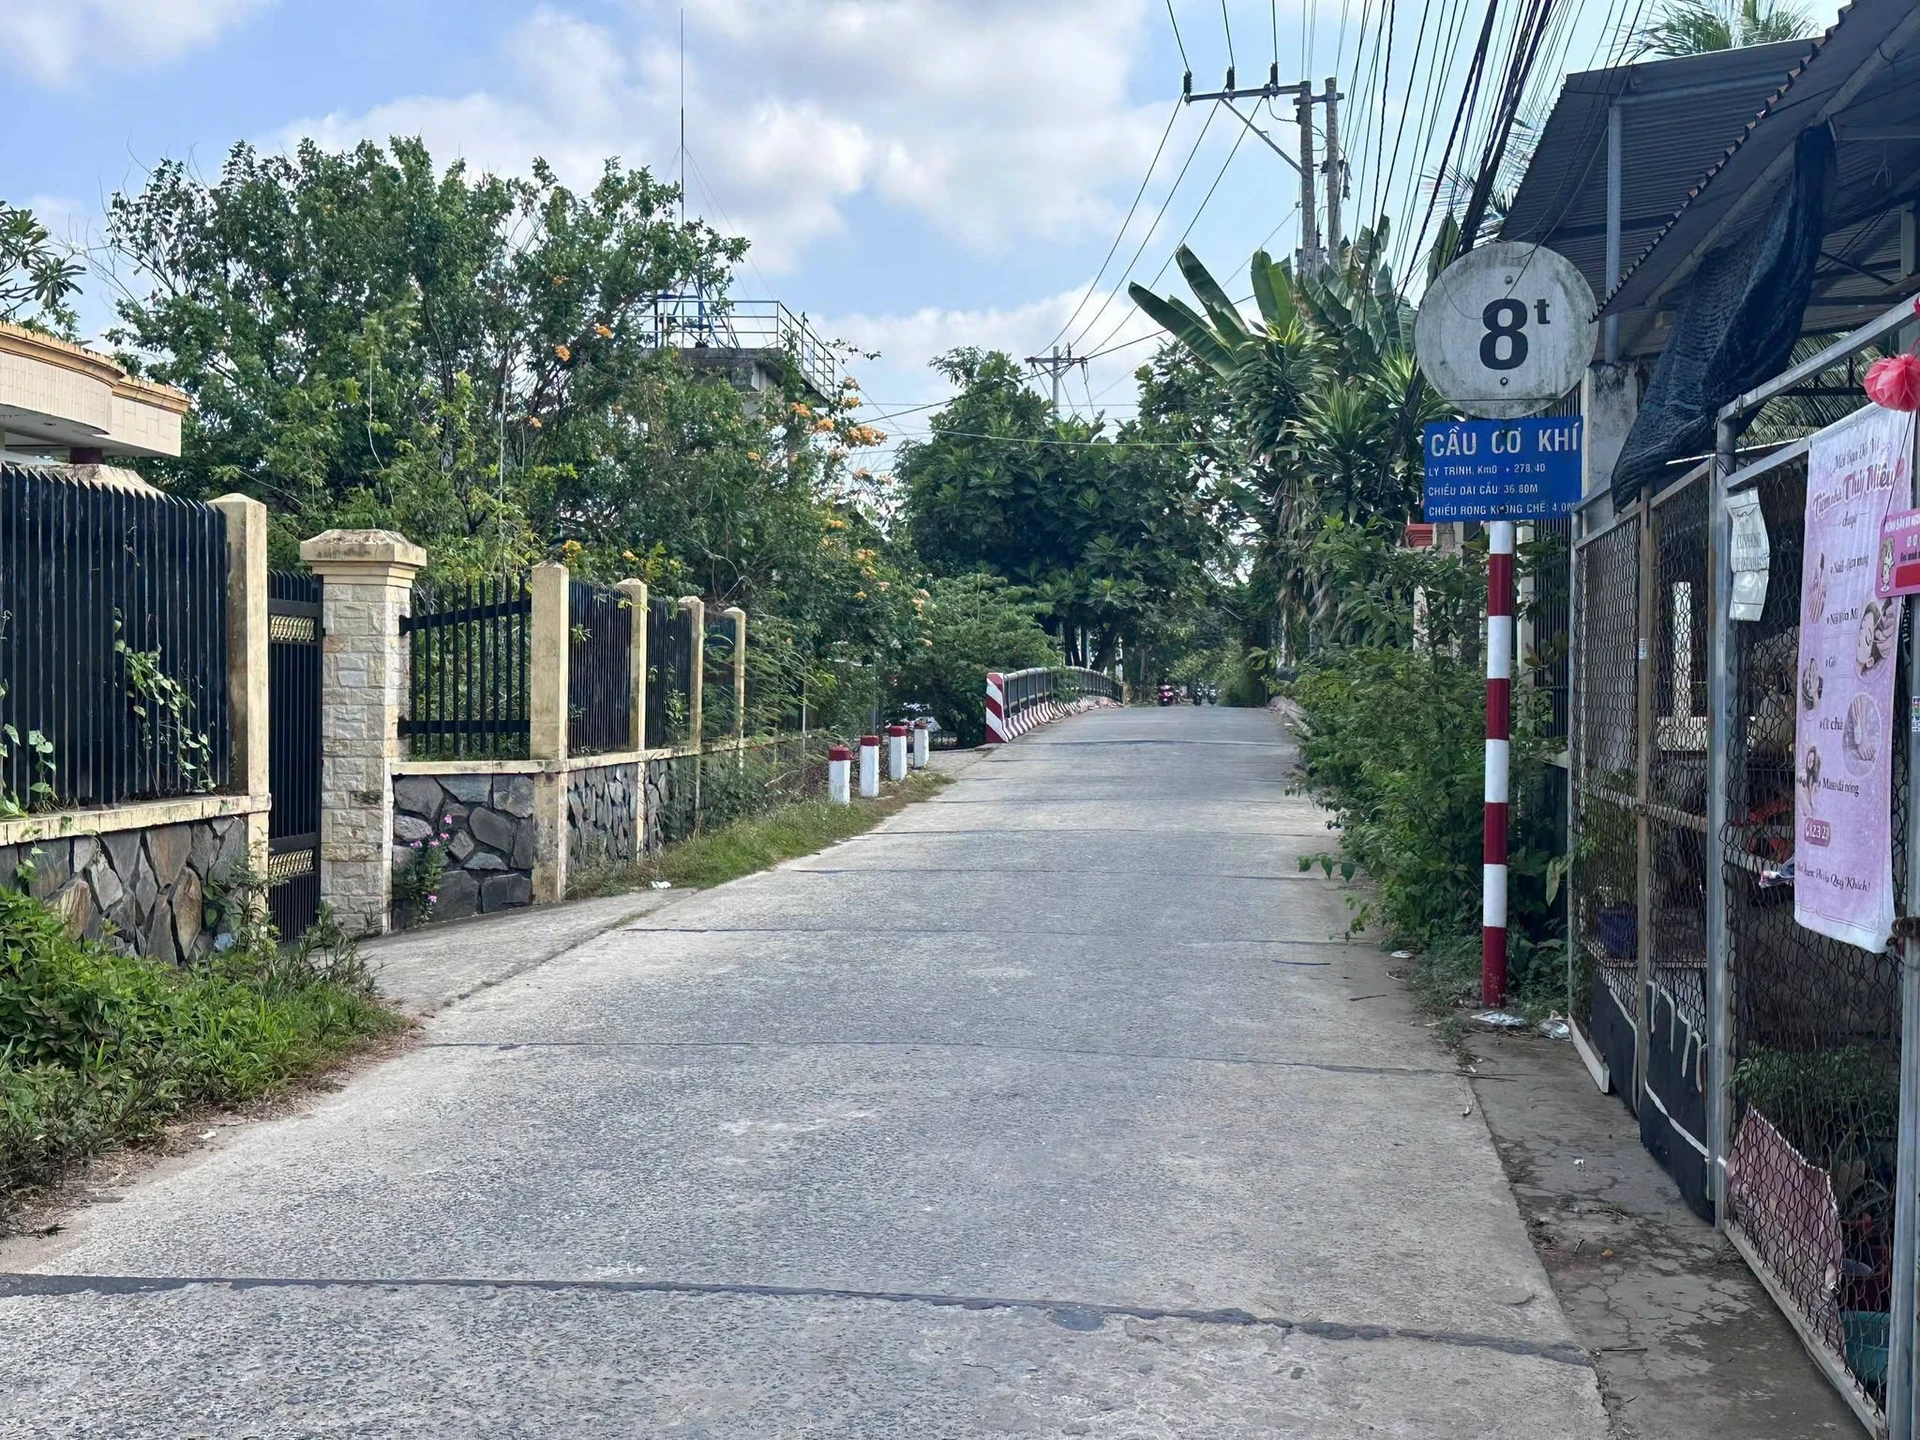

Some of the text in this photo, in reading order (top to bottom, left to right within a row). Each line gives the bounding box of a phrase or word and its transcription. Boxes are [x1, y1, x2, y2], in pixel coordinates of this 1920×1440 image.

[1431, 422, 1580, 457] CẦU CƠ KHÍ
